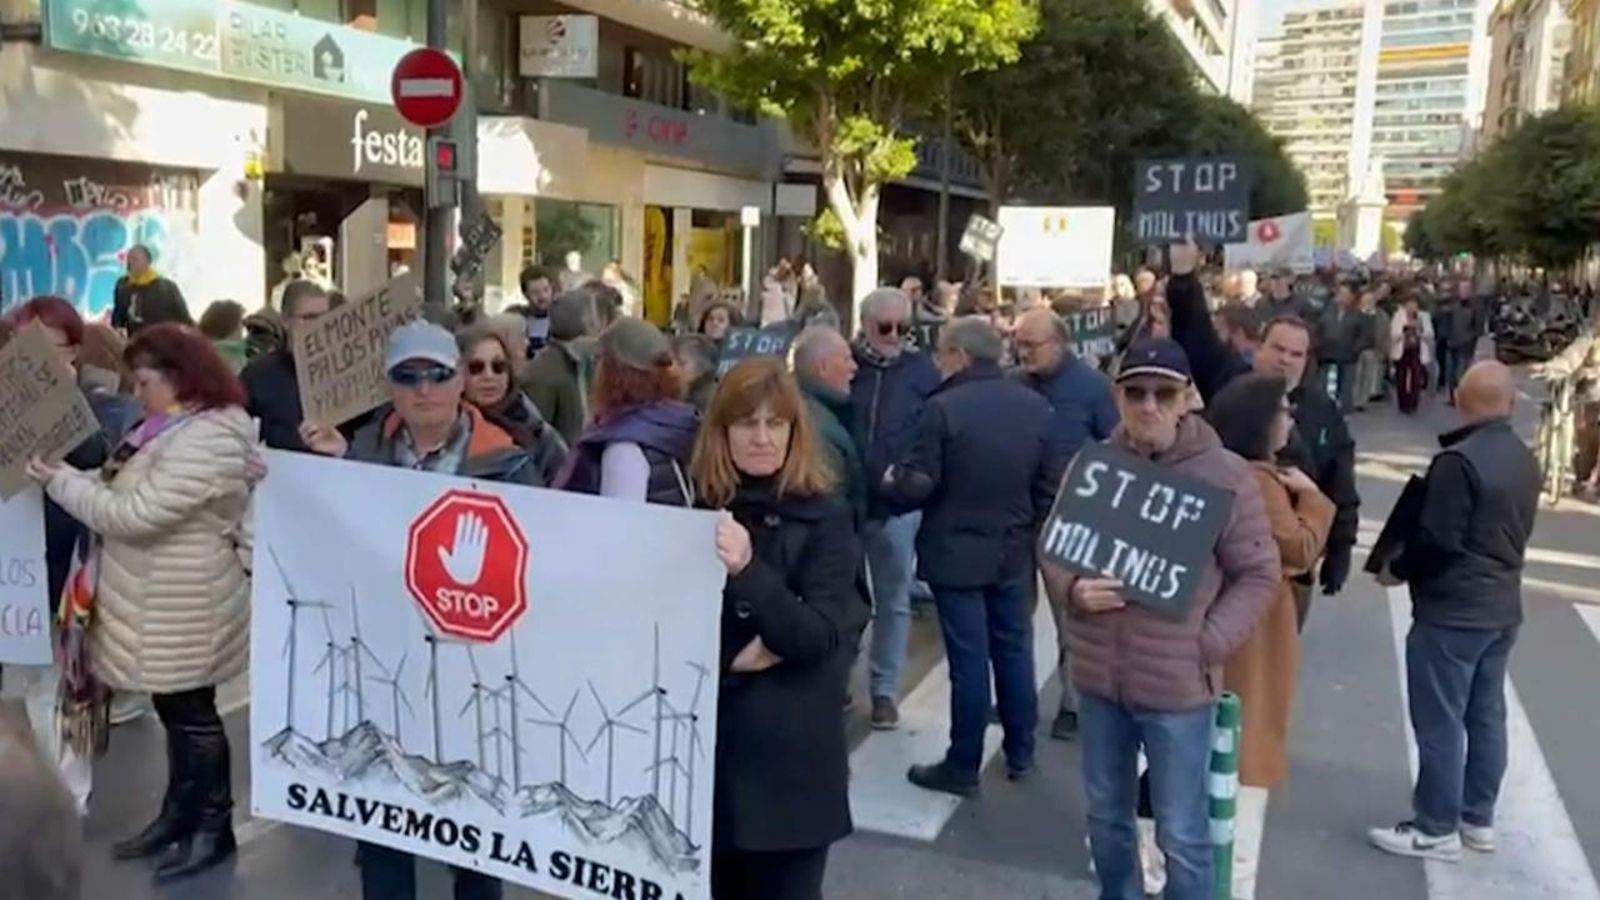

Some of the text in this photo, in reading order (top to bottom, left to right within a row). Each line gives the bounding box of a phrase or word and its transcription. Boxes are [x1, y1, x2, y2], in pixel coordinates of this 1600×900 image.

[72, 8, 121, 41] 963
[124, 17, 155, 49] 28
[159, 26, 187, 54] 24
[350, 108, 424, 175] festa
[1145, 162, 1237, 193] STOP
[1137, 209, 1242, 240] MOLINOS
[304, 288, 391, 358] EL MONTE
[1074, 460, 1205, 530] STOP
[1044, 514, 1188, 600] MOLINOS
[436, 587, 500, 620] STOP
[286, 783, 687, 900] SALVEMOS LA SIERR
